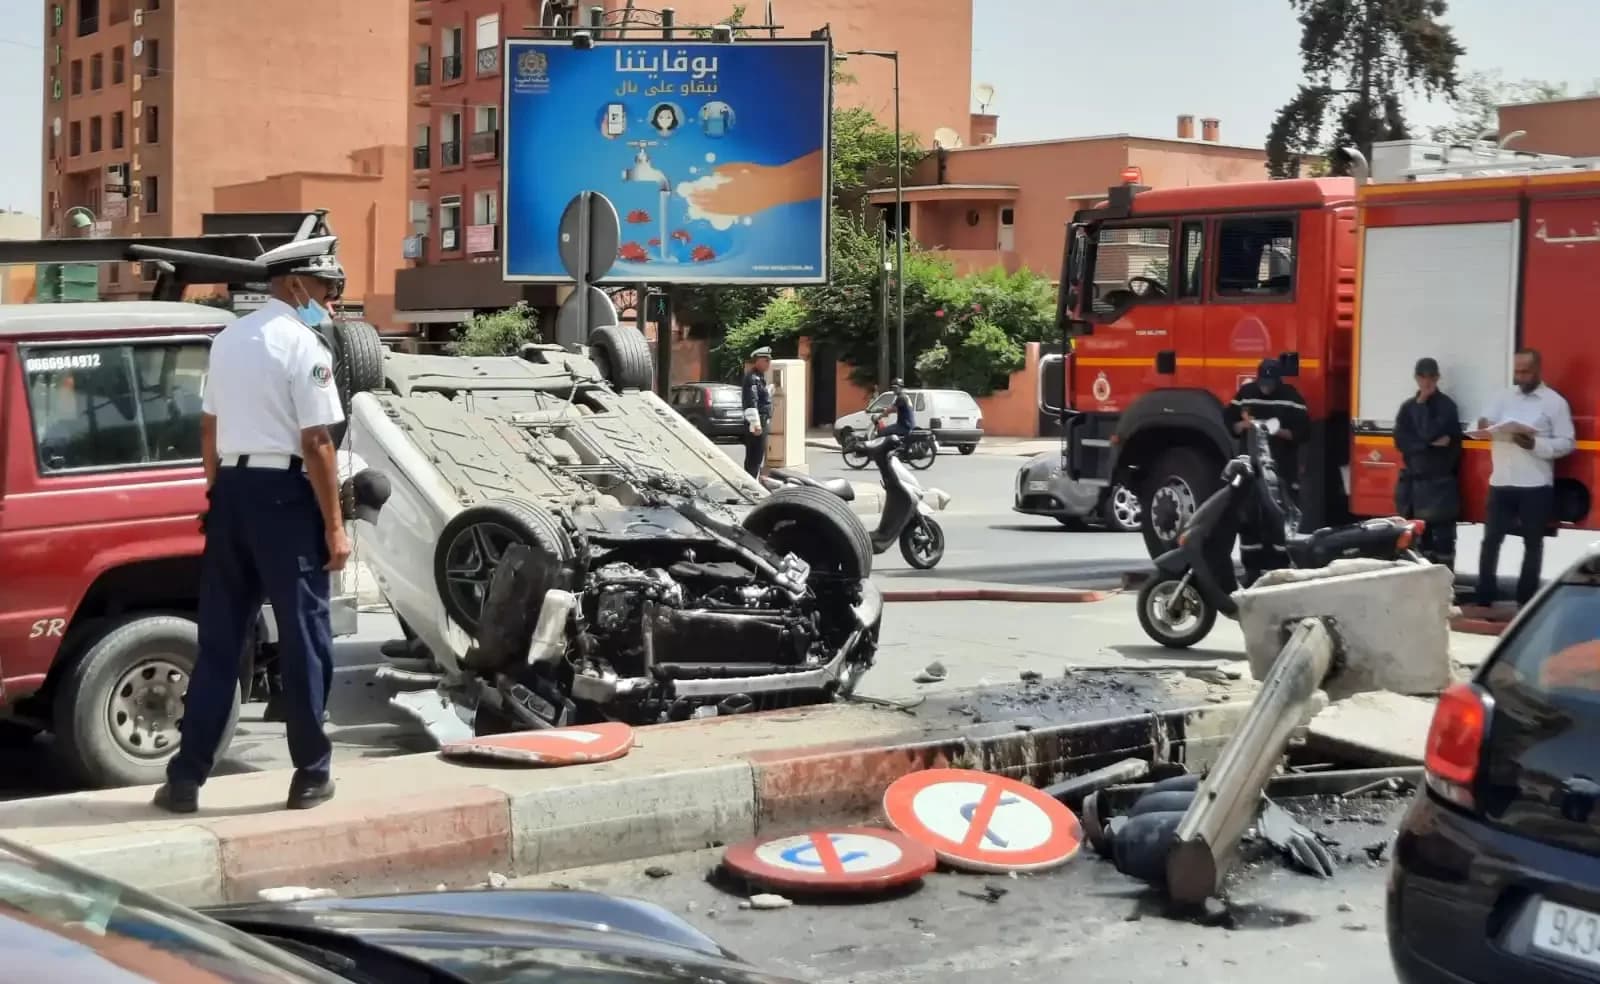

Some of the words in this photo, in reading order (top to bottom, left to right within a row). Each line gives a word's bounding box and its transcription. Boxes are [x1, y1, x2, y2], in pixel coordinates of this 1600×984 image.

[615, 49, 718, 79] بوقايتنا
[644, 79, 674, 97] على
[29, 618, 66, 638] SR
[1548, 909, 1600, 955] 943
